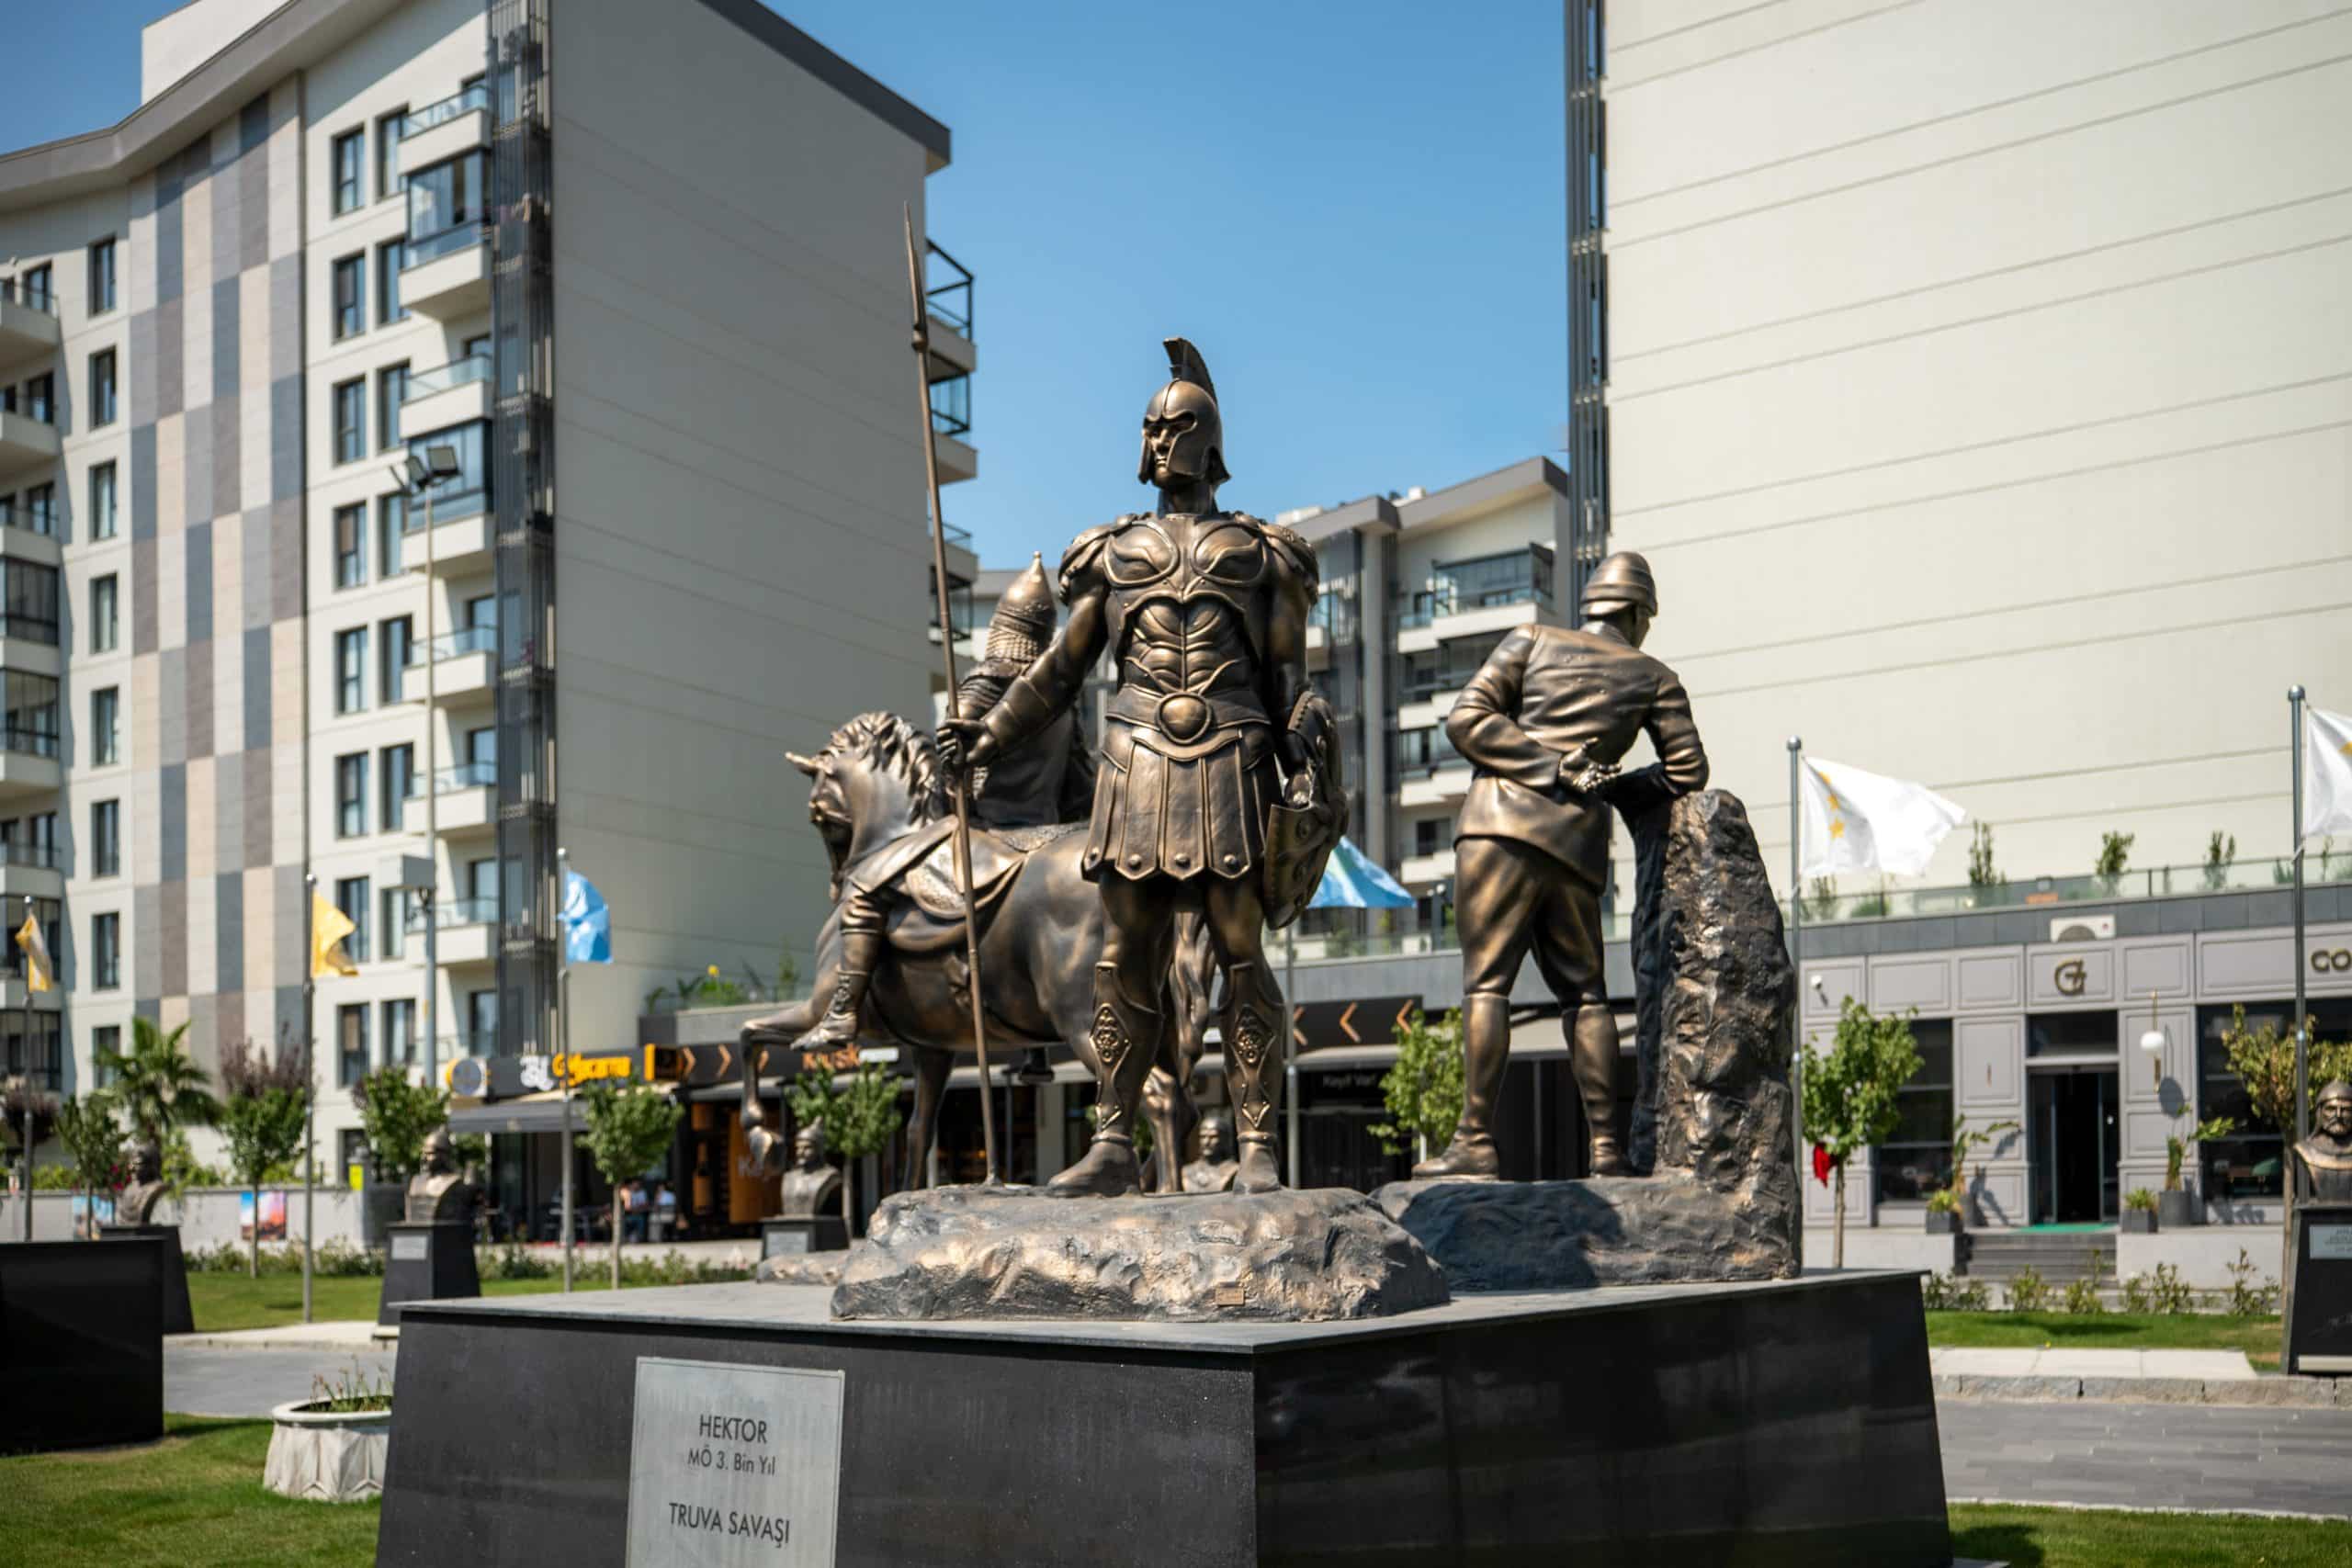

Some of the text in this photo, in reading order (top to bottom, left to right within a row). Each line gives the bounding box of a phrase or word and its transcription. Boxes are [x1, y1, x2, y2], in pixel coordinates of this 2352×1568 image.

[699, 1415, 767, 1443] HEKTOR
[688, 1444, 775, 1475] MÖ 3. Bin Yıl
[669, 1502, 790, 1549] TRUVA SAVAŞI
